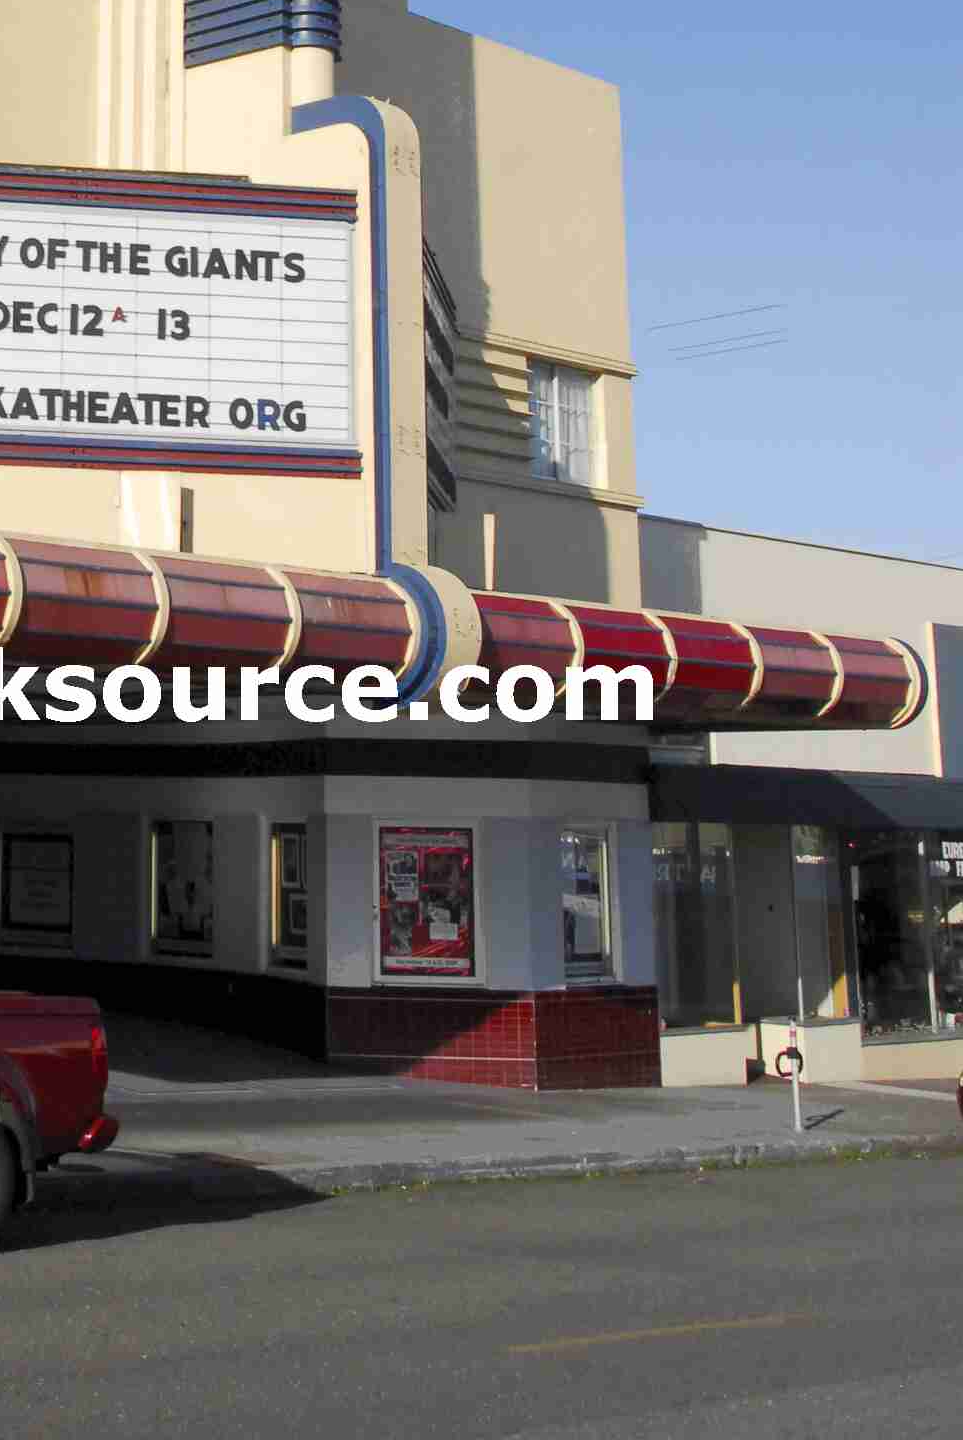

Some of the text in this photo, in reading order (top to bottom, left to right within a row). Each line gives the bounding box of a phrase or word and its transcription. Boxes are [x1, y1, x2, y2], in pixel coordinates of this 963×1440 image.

[19, 238, 70, 270] OF
[75, 240, 151, 276] THE
[165, 245, 306, 283] GIANTS
[69, 303, 104, 337] 12
[157, 308, 191, 341] 13
[229, 398, 307, 432] ORG
